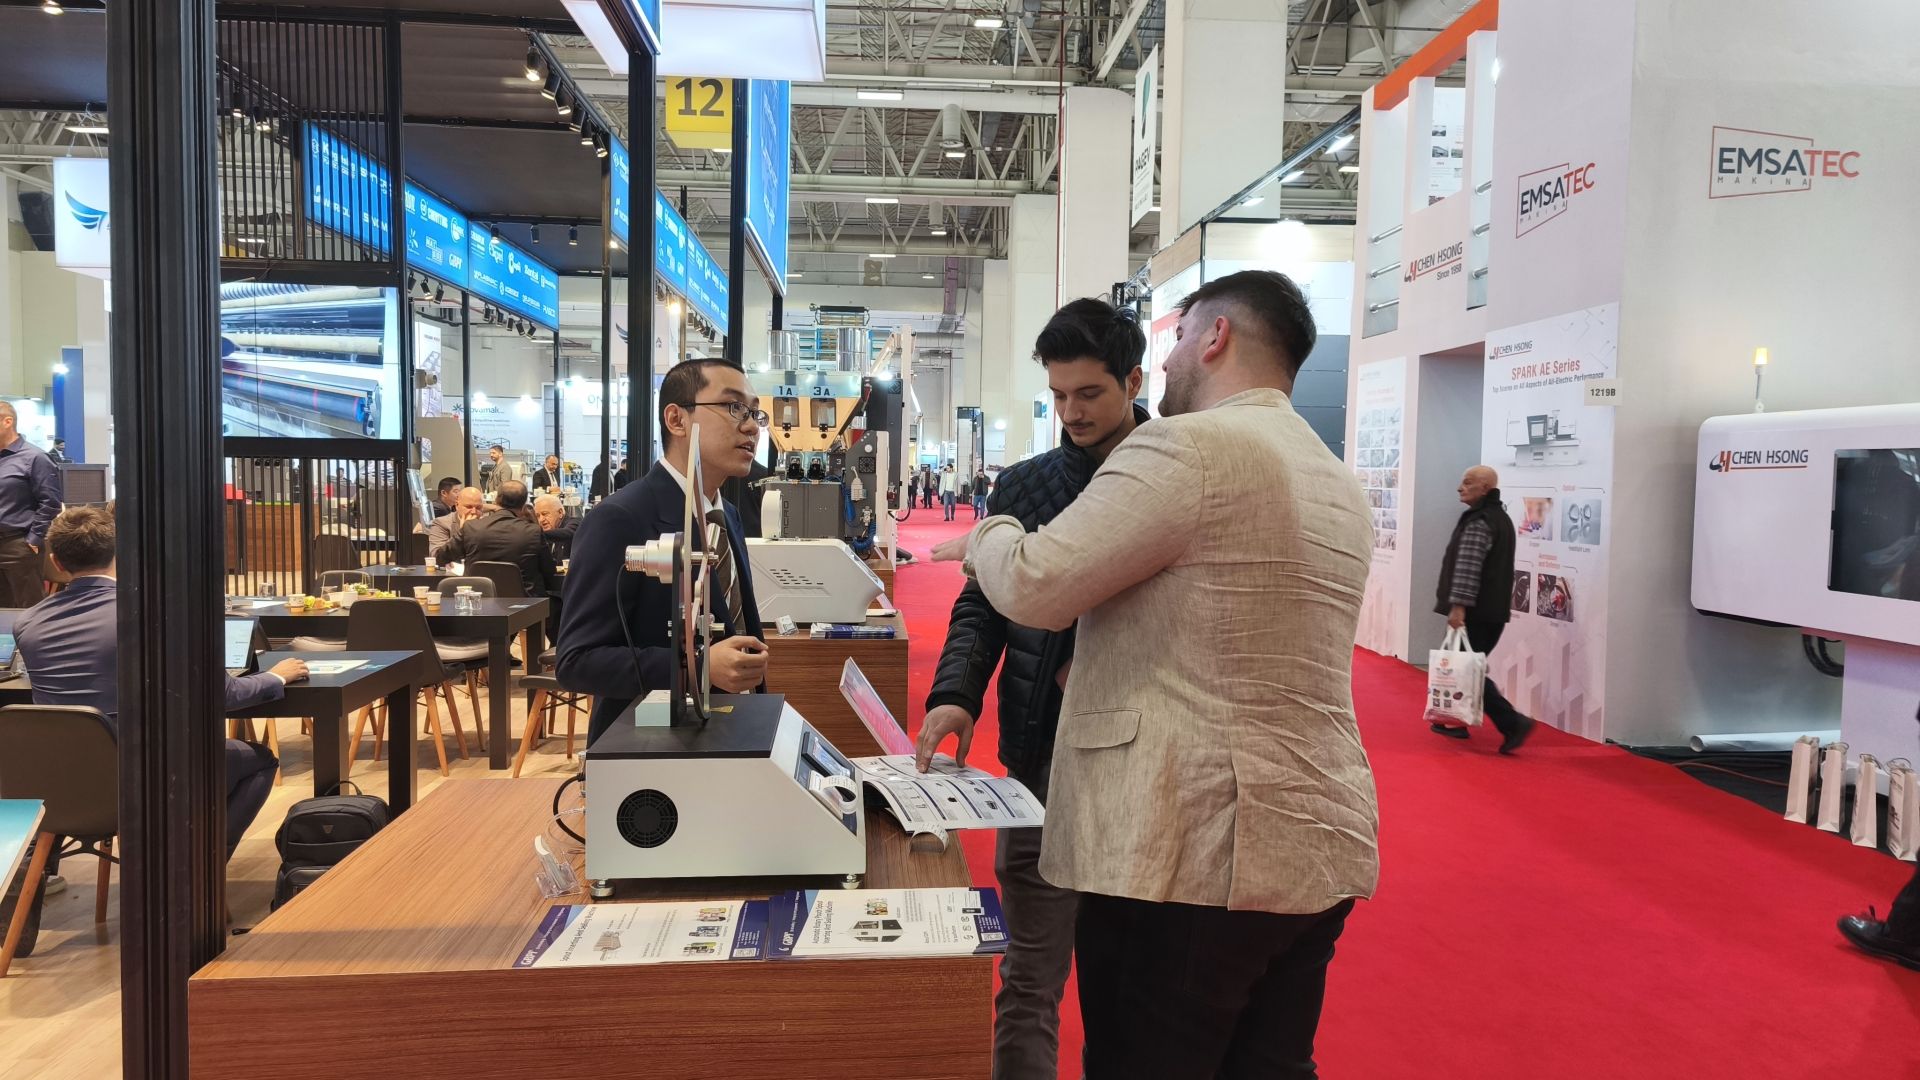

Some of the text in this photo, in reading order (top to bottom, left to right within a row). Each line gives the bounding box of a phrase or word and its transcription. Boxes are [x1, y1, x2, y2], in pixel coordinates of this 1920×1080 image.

[676, 78, 724, 117] 12
[1719, 147, 1861, 178] EMSATEC
[1521, 162, 1596, 216] EMSATEC
[1418, 241, 1463, 272] CHEN HSONG
[1436, 270, 1450, 280] Since
[1499, 340, 1533, 355] CHEN HSONG
[1511, 358, 1581, 381] SPARK AE Series
[1548, 373, 1573, 386] All-Electric
[1590, 388, 1616, 397] 1219B
[1731, 449, 1809, 464] CHEN HSONG
